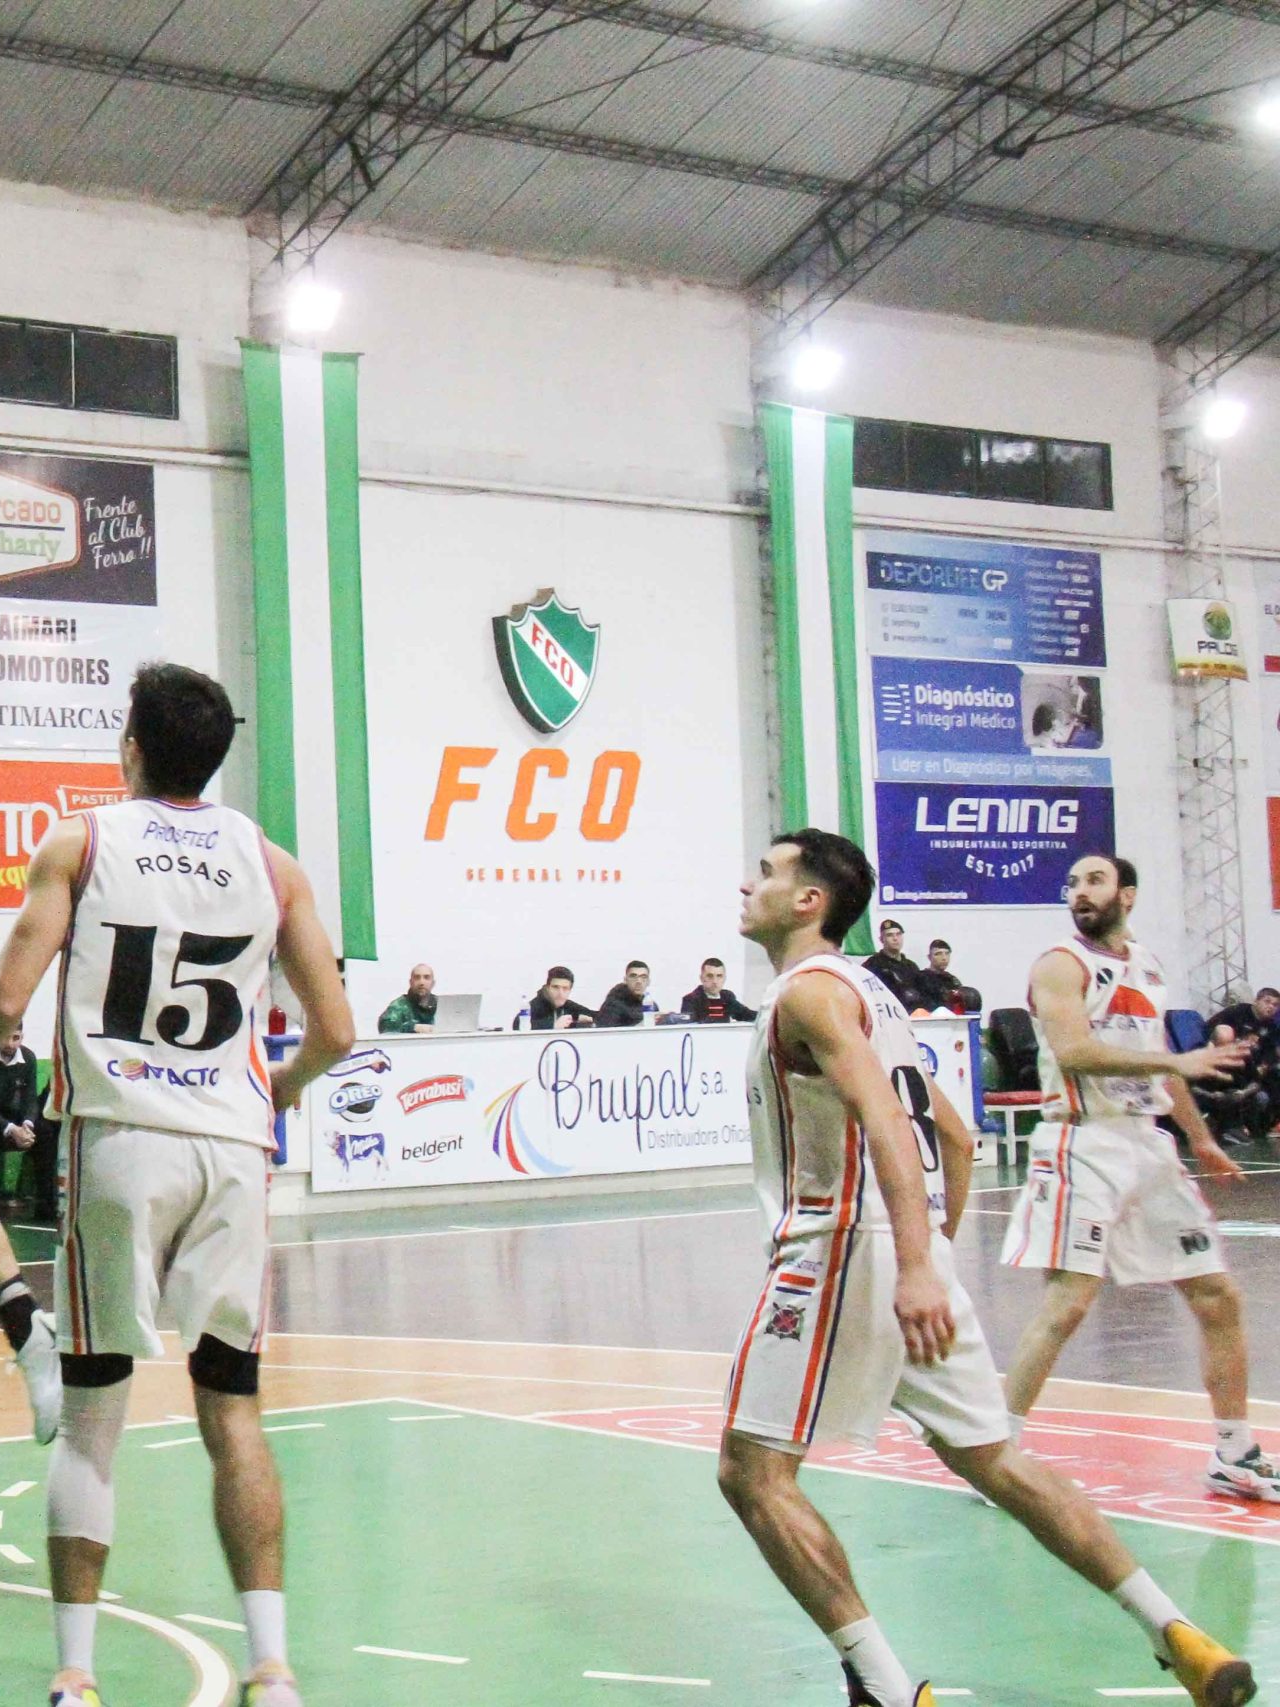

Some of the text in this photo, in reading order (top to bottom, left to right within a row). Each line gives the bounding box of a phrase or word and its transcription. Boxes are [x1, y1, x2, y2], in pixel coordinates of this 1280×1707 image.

[83, 495, 137, 522] Frente
[88, 514, 146, 546] al Club
[92, 544, 136, 570] Ferro
[531, 621, 574, 688] FCO
[914, 683, 1015, 711] Diagnóstico
[916, 711, 1016, 730] Integral Médico
[71, 794, 132, 806] PASTELE
[424, 746, 642, 842] FCO
[915, 796, 1080, 834] LENING
[930, 840, 1068, 850] INDUMENTARIA DEPORTIVA
[135, 853, 233, 889] ROSAS
[965, 854, 1036, 879] EST. 2017
[86, 921, 255, 1052] 15
[329, 1085, 382, 1112] OREO
[399, 1077, 464, 1111] Terrabusi
[538, 1032, 728, 1154] Brupal s.a.
[401, 1135, 464, 1161] beldent
[647, 1129, 719, 1150] Distribuidora
